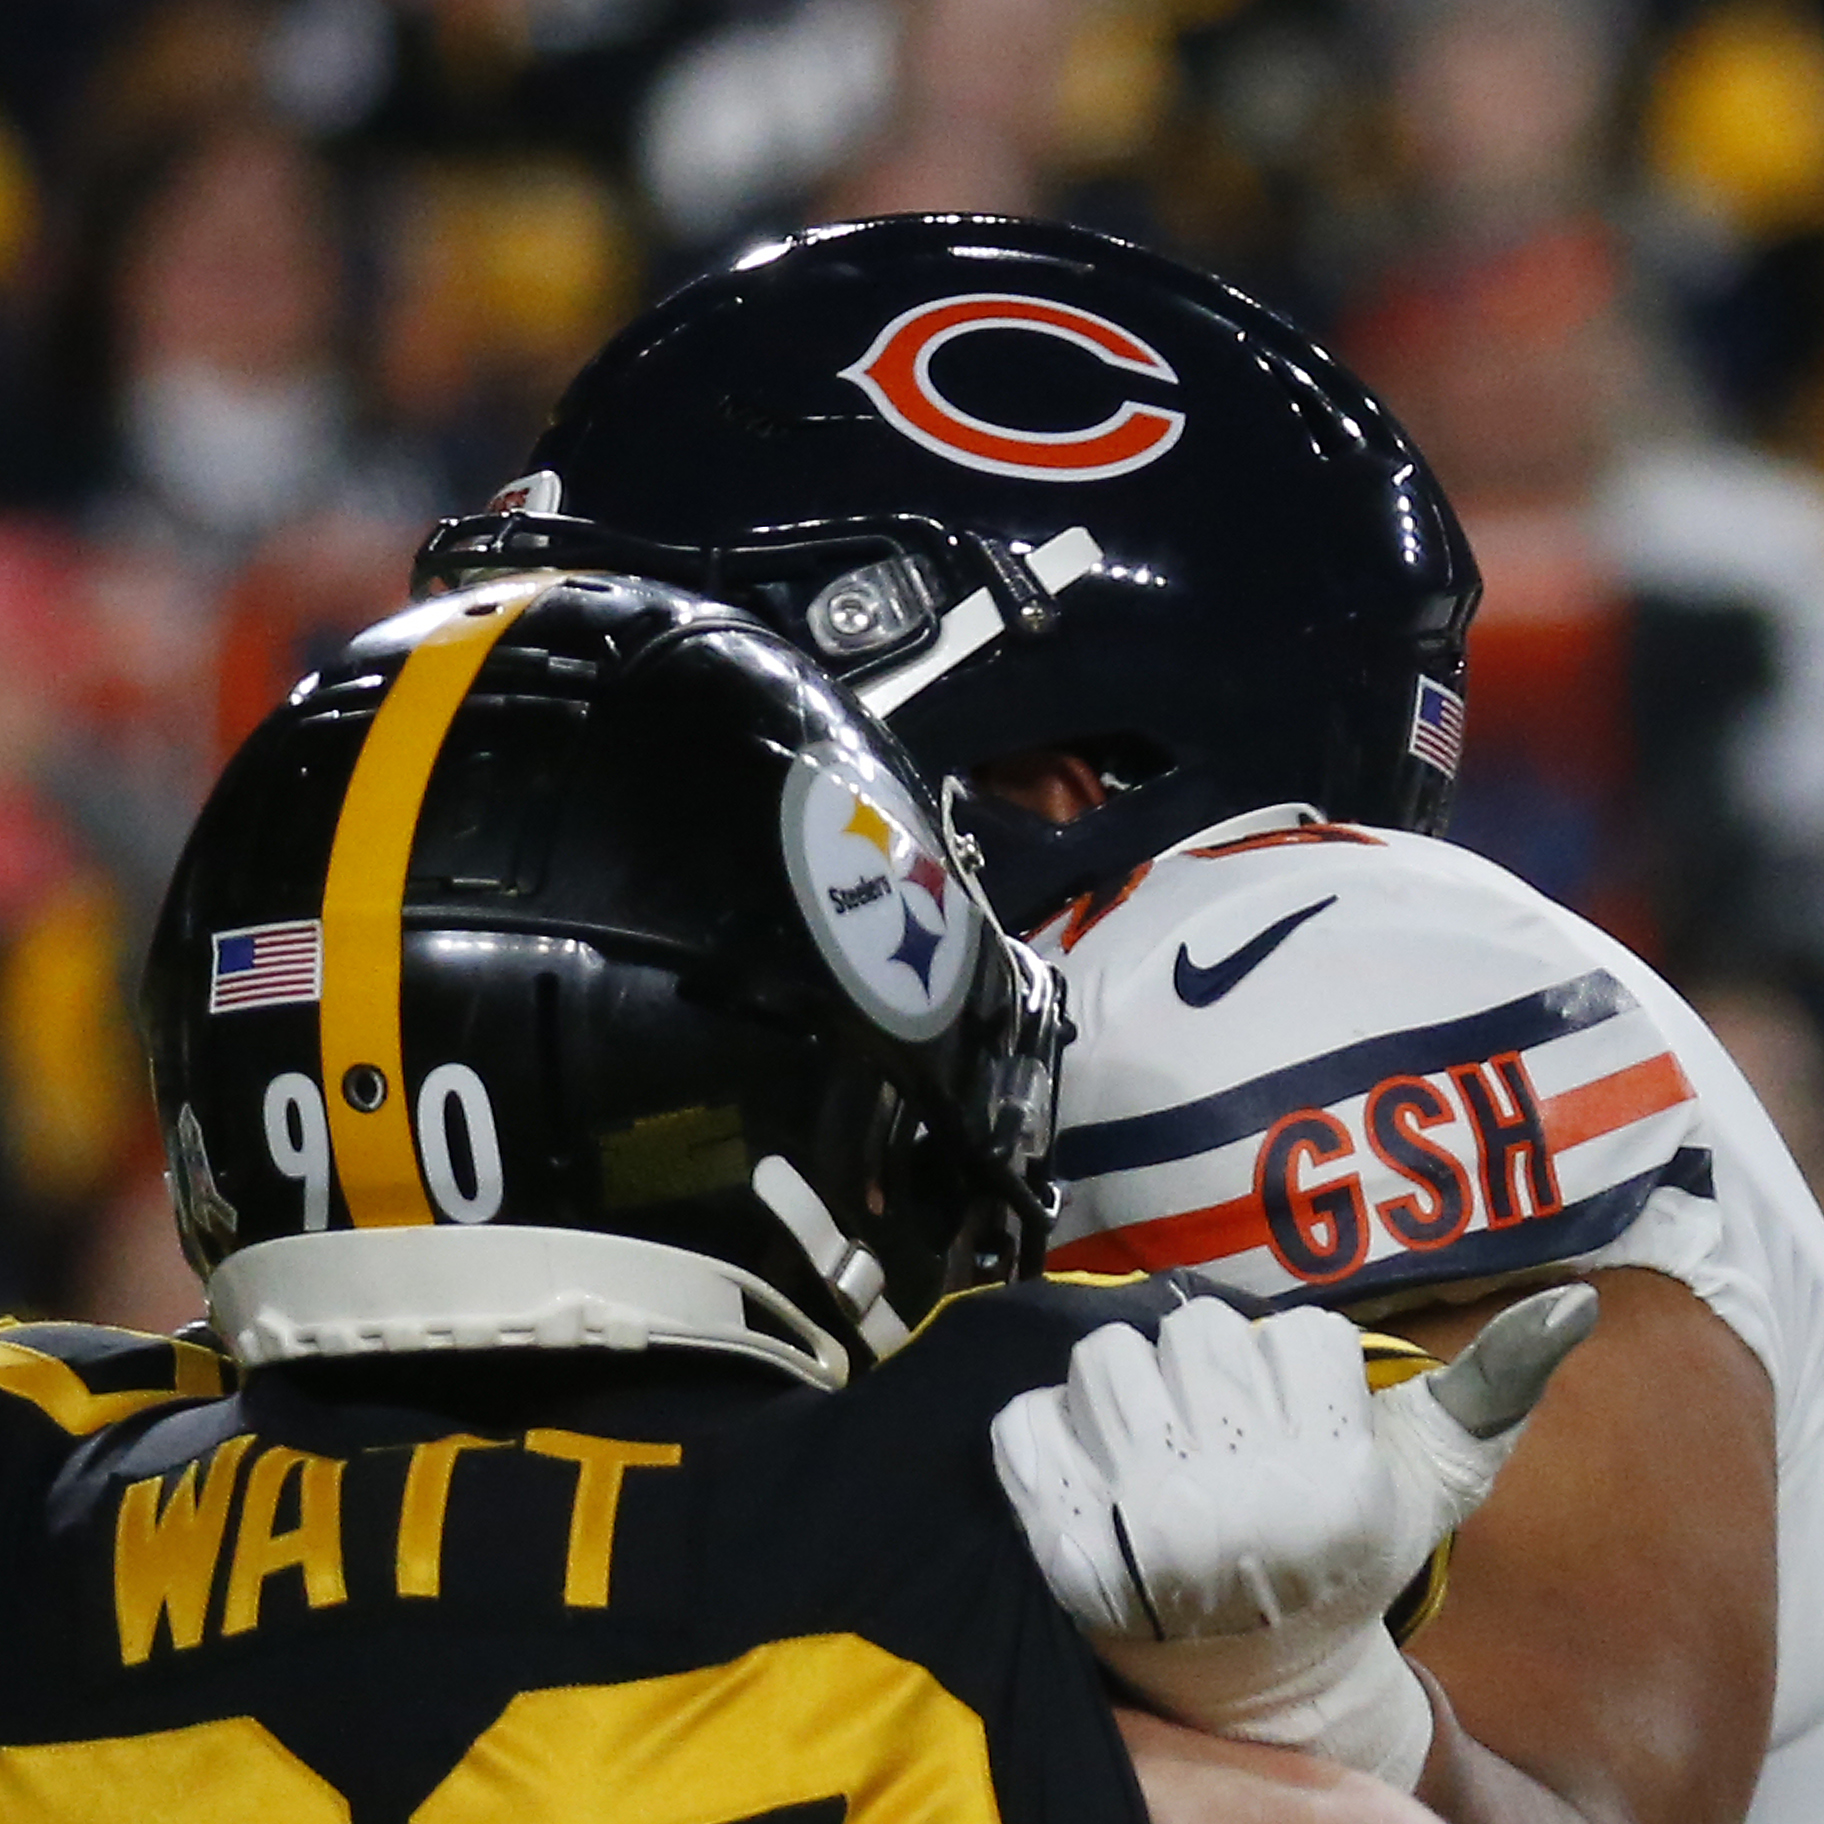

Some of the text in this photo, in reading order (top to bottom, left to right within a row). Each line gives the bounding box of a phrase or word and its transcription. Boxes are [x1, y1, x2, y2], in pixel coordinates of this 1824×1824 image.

[836, 293, 1187, 482] C
[263, 1062, 504, 1233] 90
[1253, 1051, 1563, 1285] GSH
[114, 1427, 683, 1667] WATT
